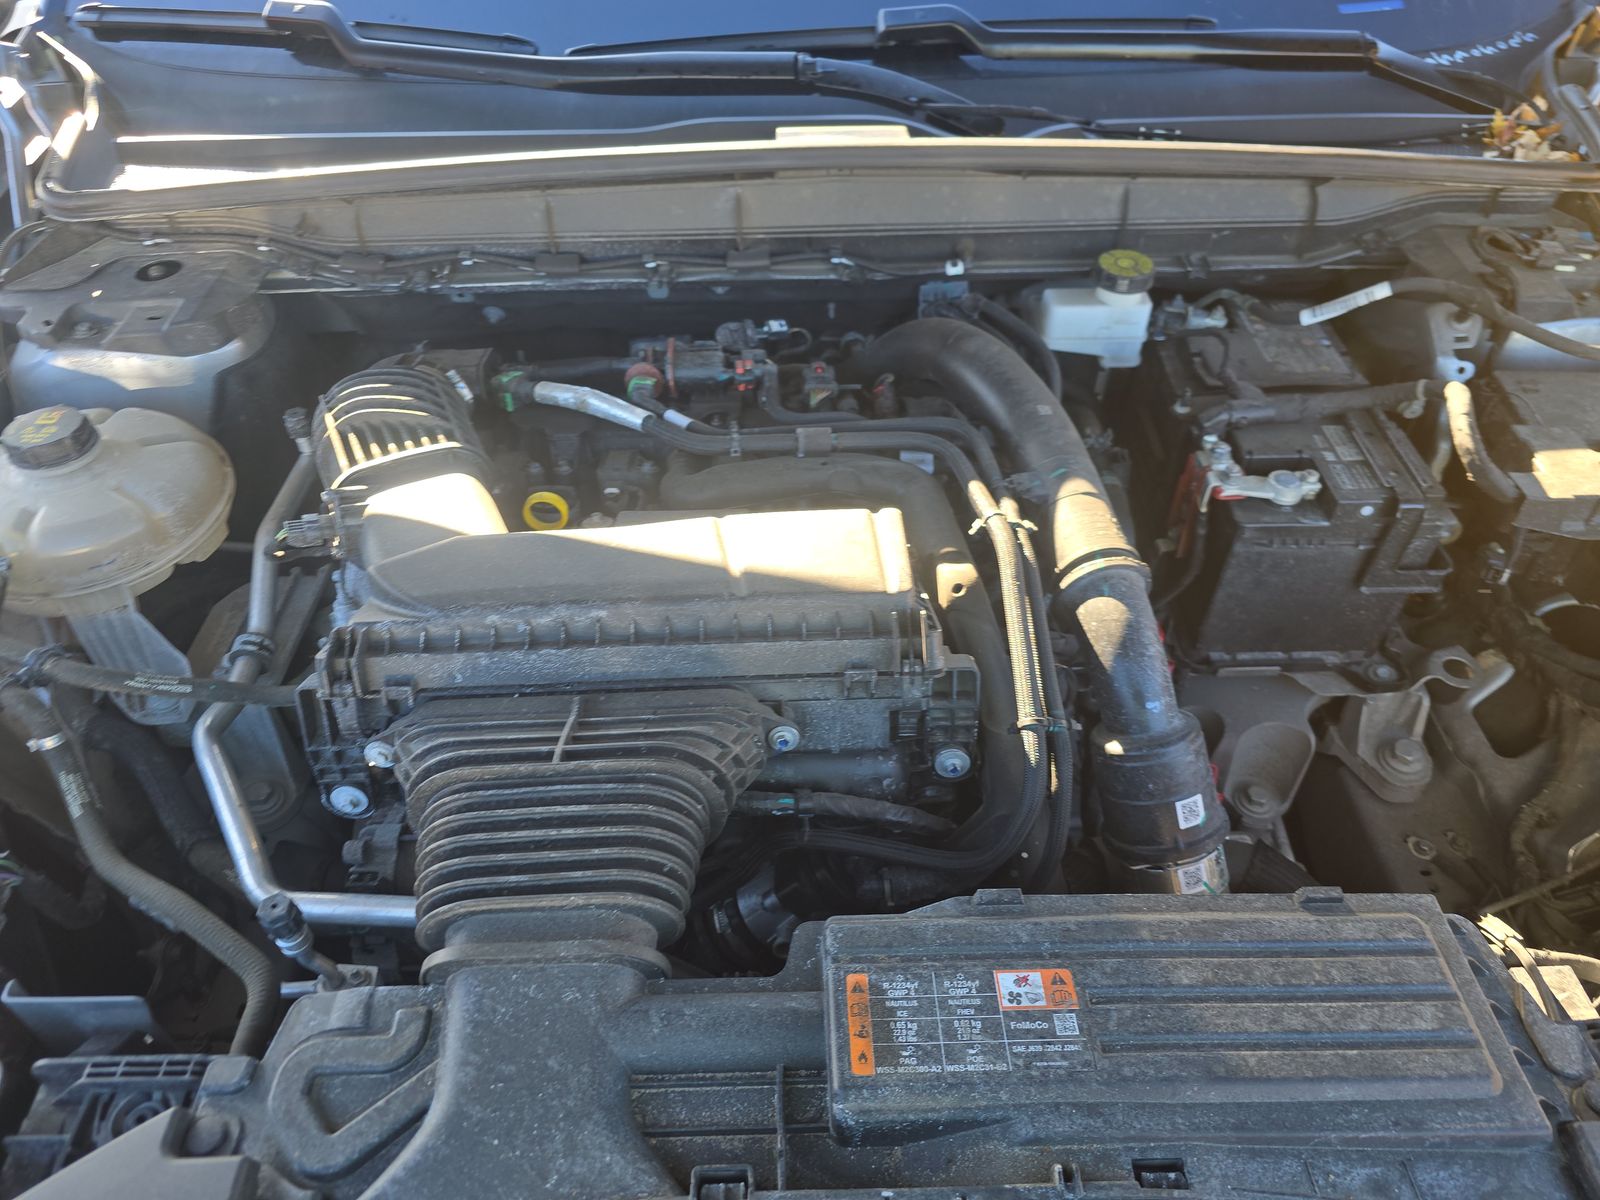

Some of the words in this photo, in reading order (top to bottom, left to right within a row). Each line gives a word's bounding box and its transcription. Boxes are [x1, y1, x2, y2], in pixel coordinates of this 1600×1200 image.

[882, 981, 920, 990] R-1234yf
[943, 979, 980, 989] R-1234yf
[947, 998, 982, 1006] NAUTILUS
[906, 1021, 918, 1031] kg
[970, 1019, 982, 1029] kg
[1010, 1020, 1049, 1030] FoMoCo
[1012, 1045, 1027, 1053] SAE
[899, 1057, 918, 1065] PAG
[966, 1055, 985, 1063] POE
